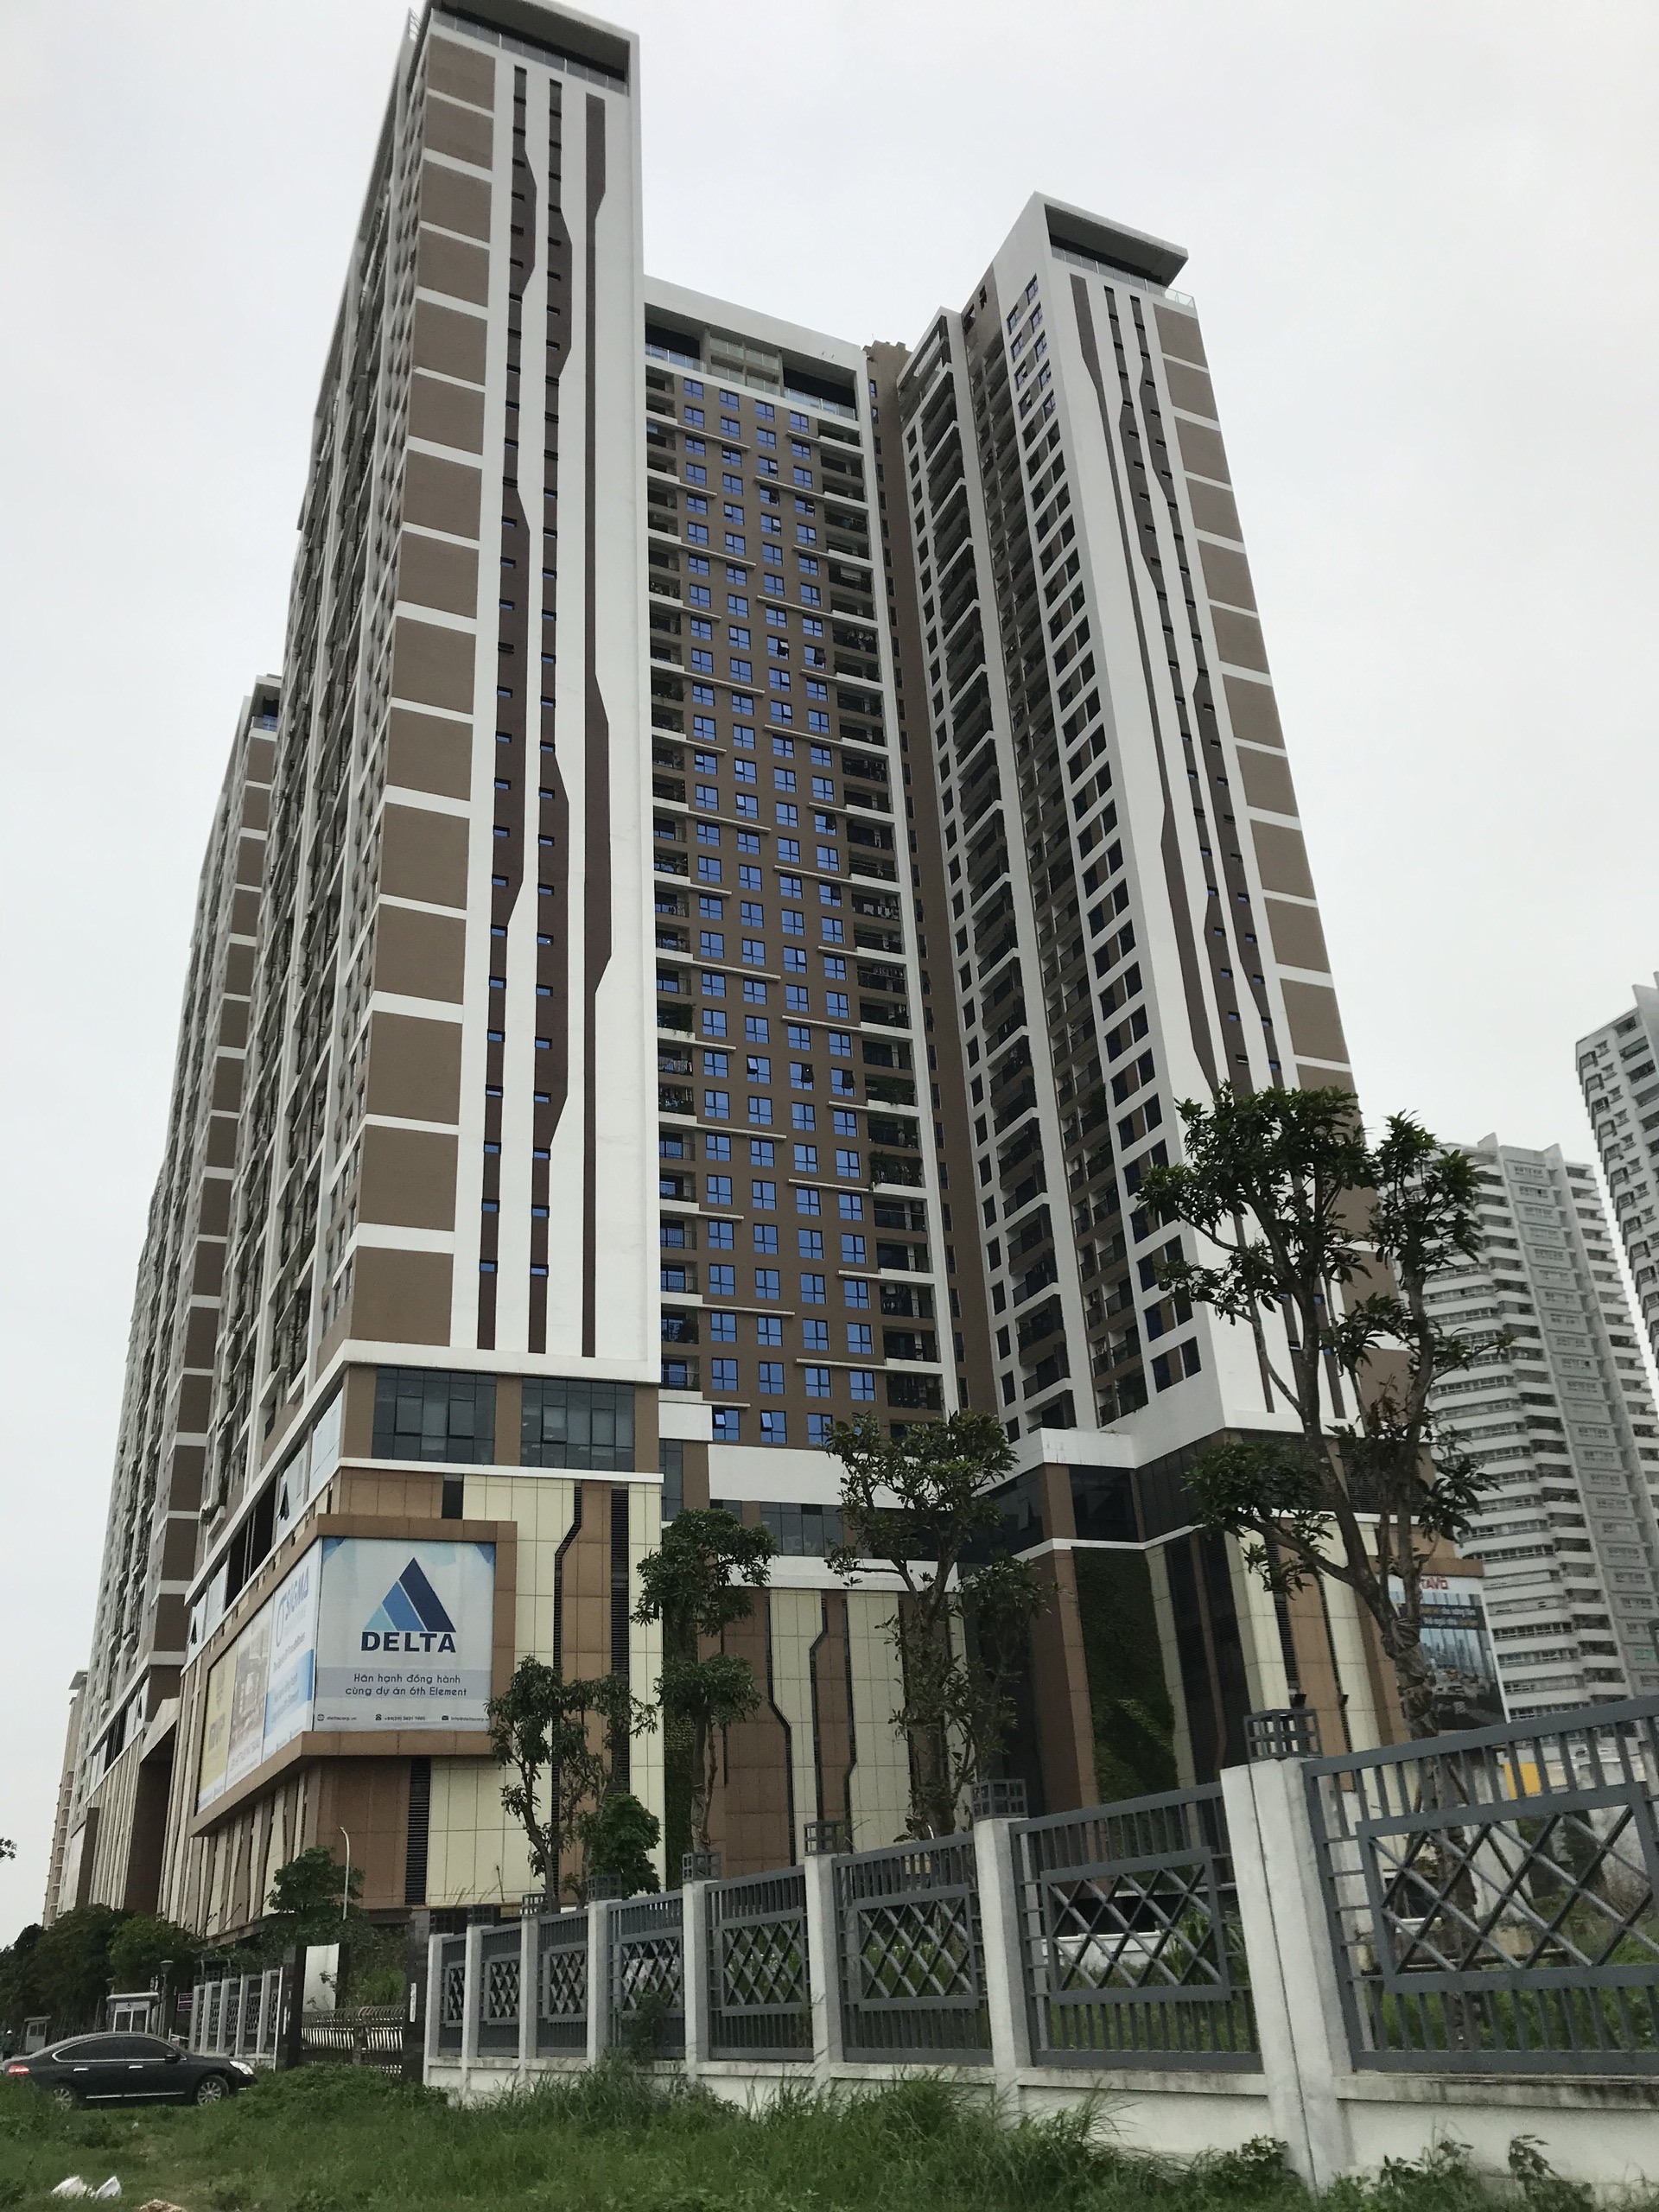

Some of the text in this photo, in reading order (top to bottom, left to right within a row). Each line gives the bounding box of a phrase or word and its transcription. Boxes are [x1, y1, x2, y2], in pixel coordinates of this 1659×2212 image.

[361, 1631, 456, 1653] DELTA
[353, 1673, 374, 1683] Hân
[378, 1674, 403, 1685] hạnh
[436, 1675, 461, 1684] hành
[346, 1687, 372, 1696] cùng
[392, 1687, 406, 1695] án
[410, 1686, 426, 1695] 6th
[429, 1687, 467, 1696] Element
